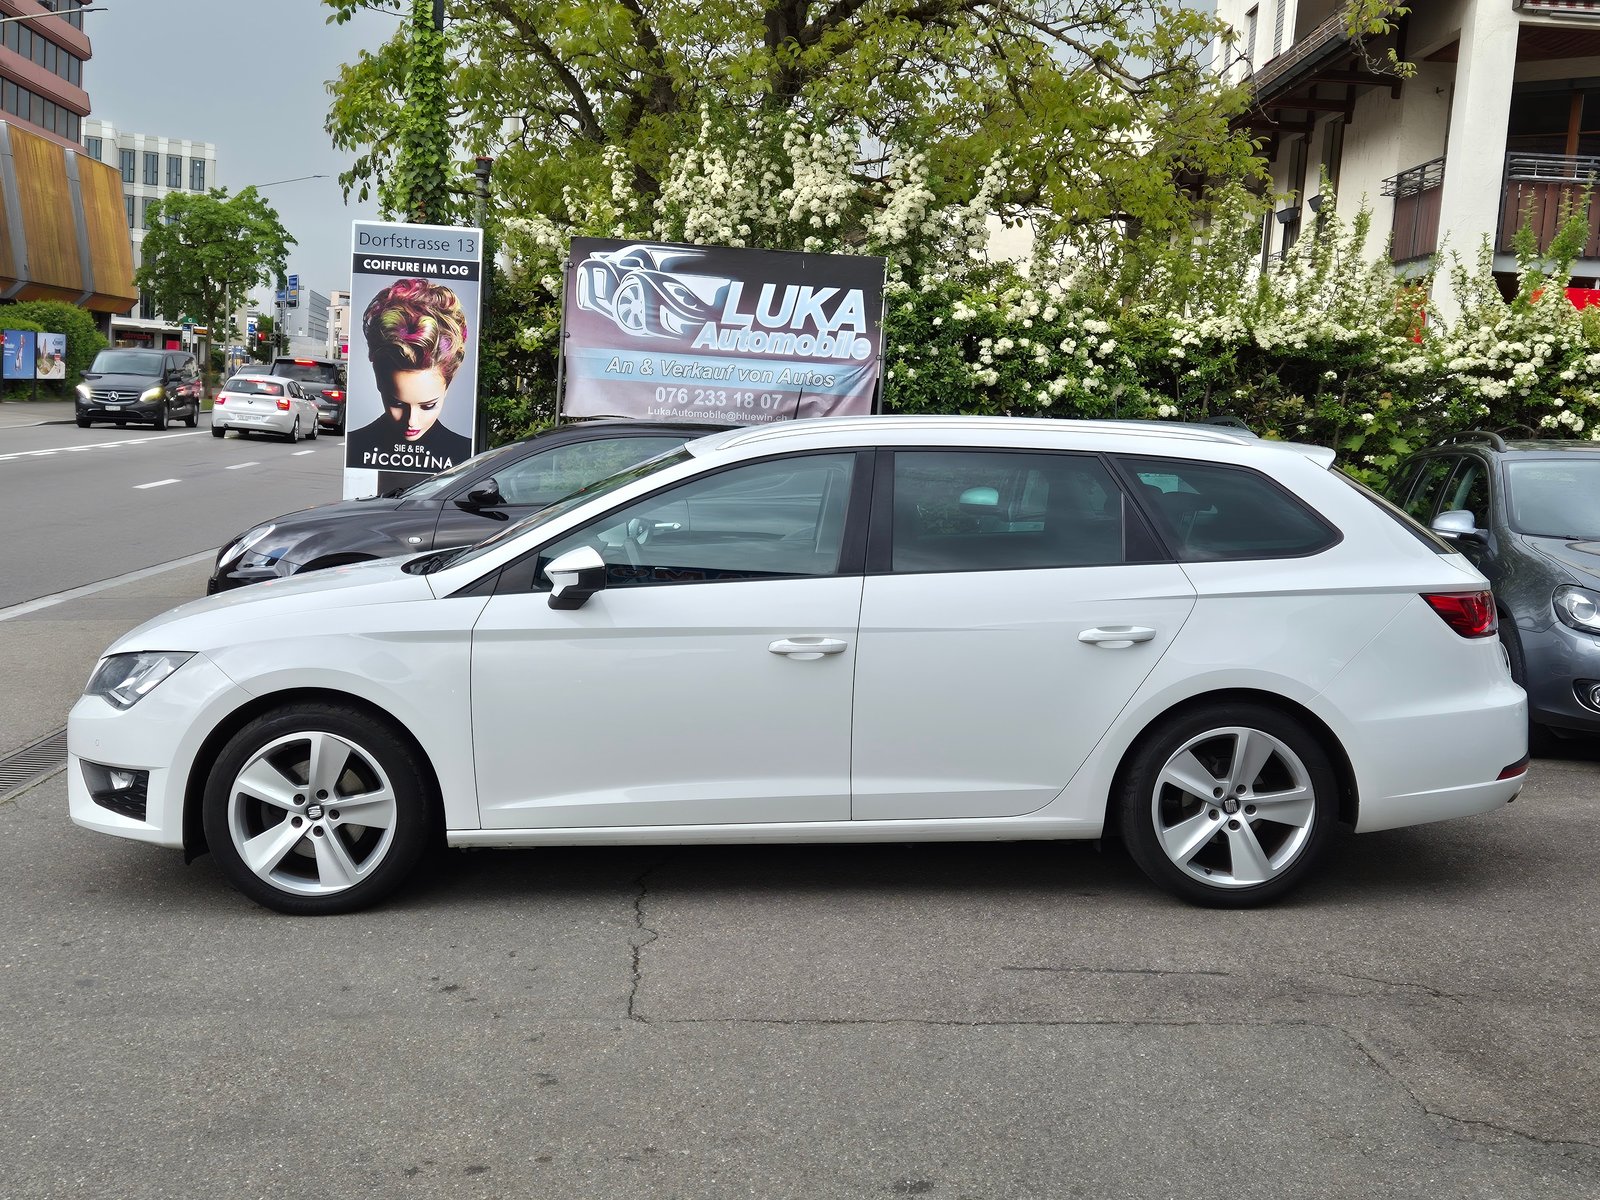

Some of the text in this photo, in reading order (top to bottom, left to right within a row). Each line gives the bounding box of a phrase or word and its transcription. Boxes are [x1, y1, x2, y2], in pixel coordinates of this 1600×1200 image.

[359, 231, 475, 253] Dorfstrasse 13
[363, 258, 469, 276] COIFFURE IM 1.OG
[720, 280, 867, 334] LUKA
[690, 321, 872, 361] Automobile
[605, 356, 837, 388] An & Verkauf von Autos
[655, 386, 783, 410] 076 233 18 07
[647, 406, 788, 422] LukaAutomobile@bluewin.ch
[393, 443, 425, 454] SIE & ER
